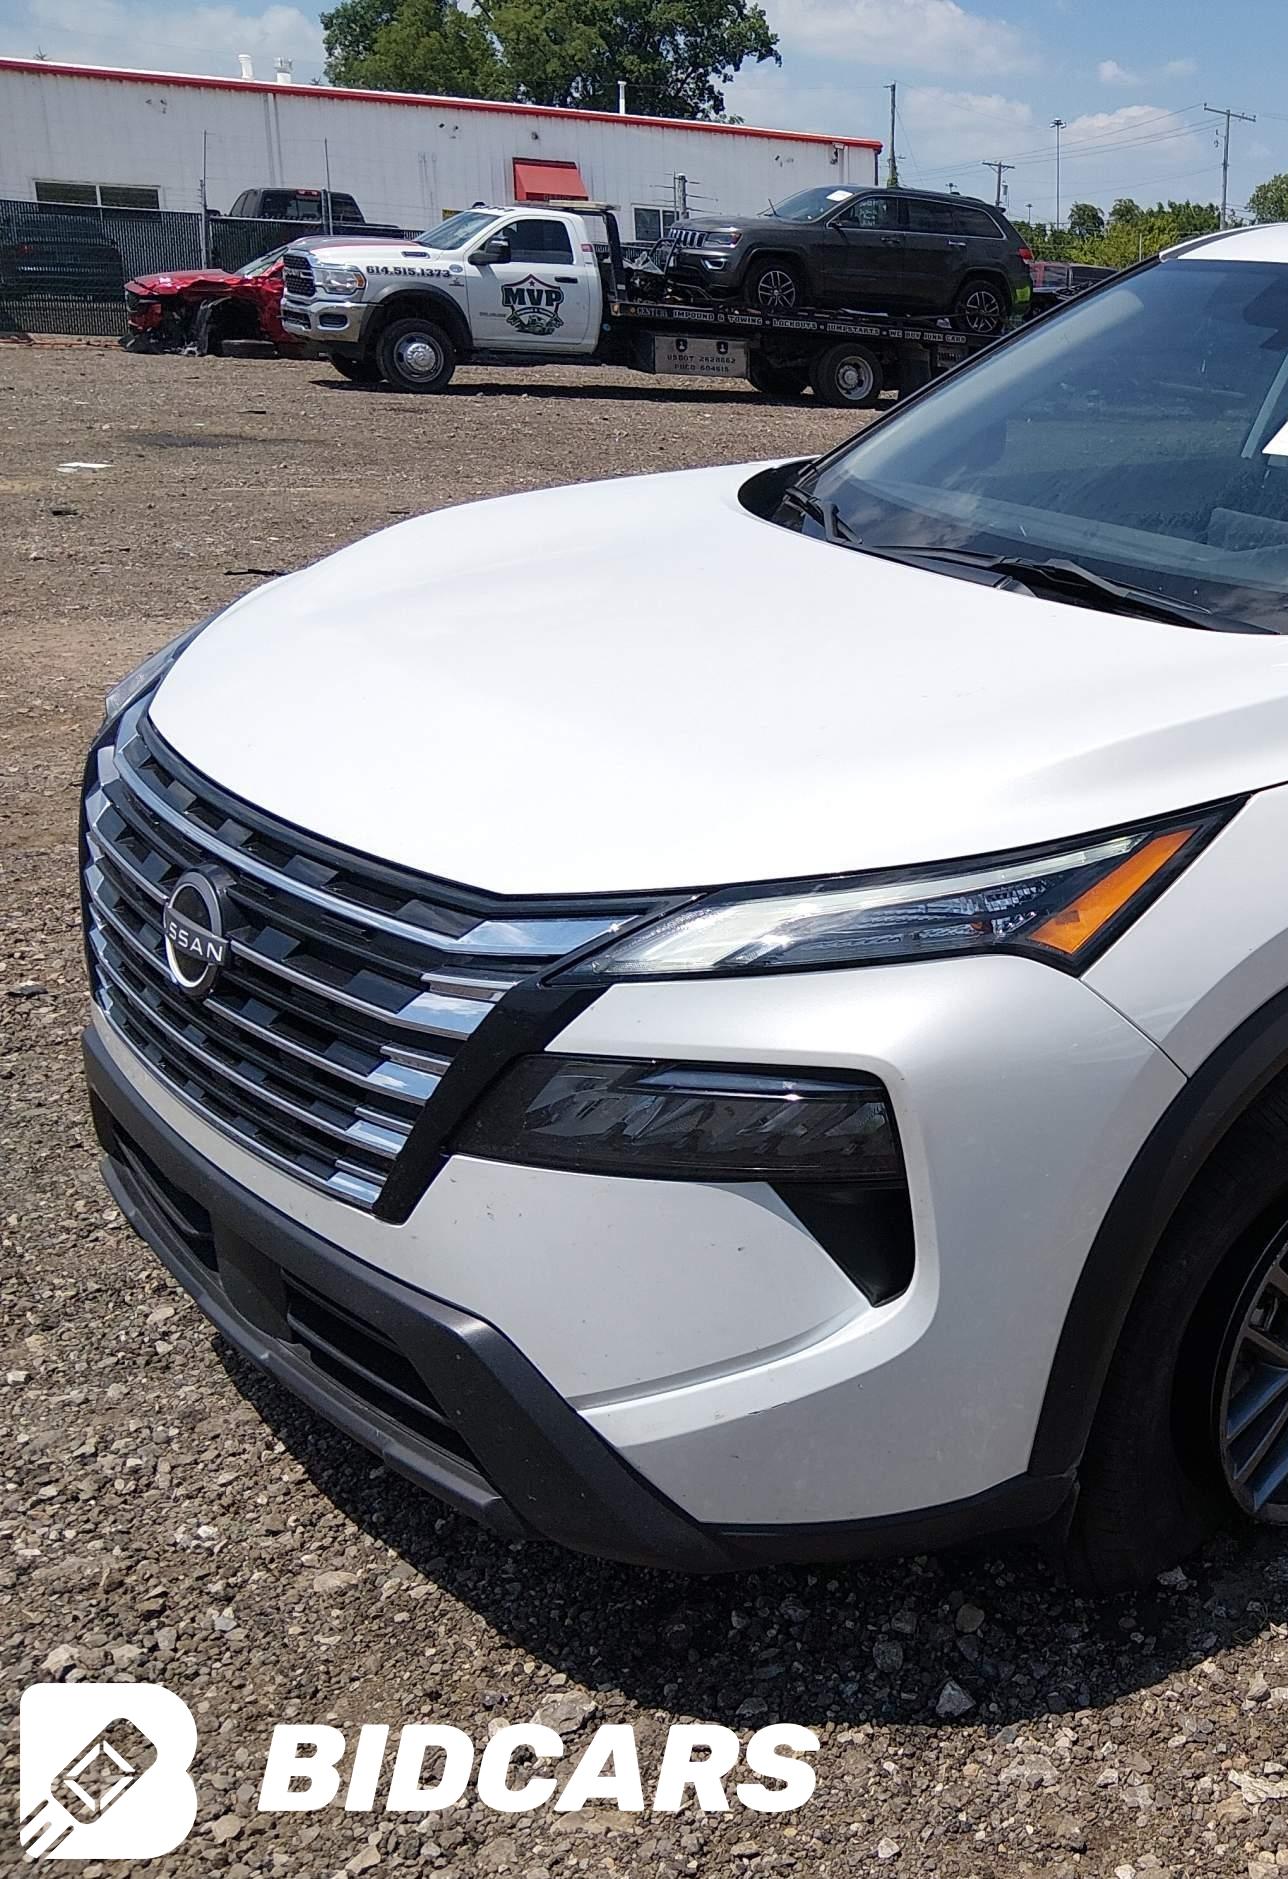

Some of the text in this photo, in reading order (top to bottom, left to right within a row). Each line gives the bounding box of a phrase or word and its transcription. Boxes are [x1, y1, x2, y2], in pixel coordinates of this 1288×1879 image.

[366, 265, 451, 278] 614.515.1373
[503, 287, 562, 306] MVP
[673, 310, 714, 321] IMPOUND
[728, 315, 762, 325] TOWING
[772, 318, 818, 330] LOCKOUTS
[826, 322, 880, 336] JUMPSTARTS
[888, 329, 903, 338] WE
[904, 330, 921, 340] BUY
[923, 332, 944, 342] JUNK
[945, 334, 967, 344] CARS
[667, 353, 695, 362] USDOT
[168, 921, 223, 962] SSAN
